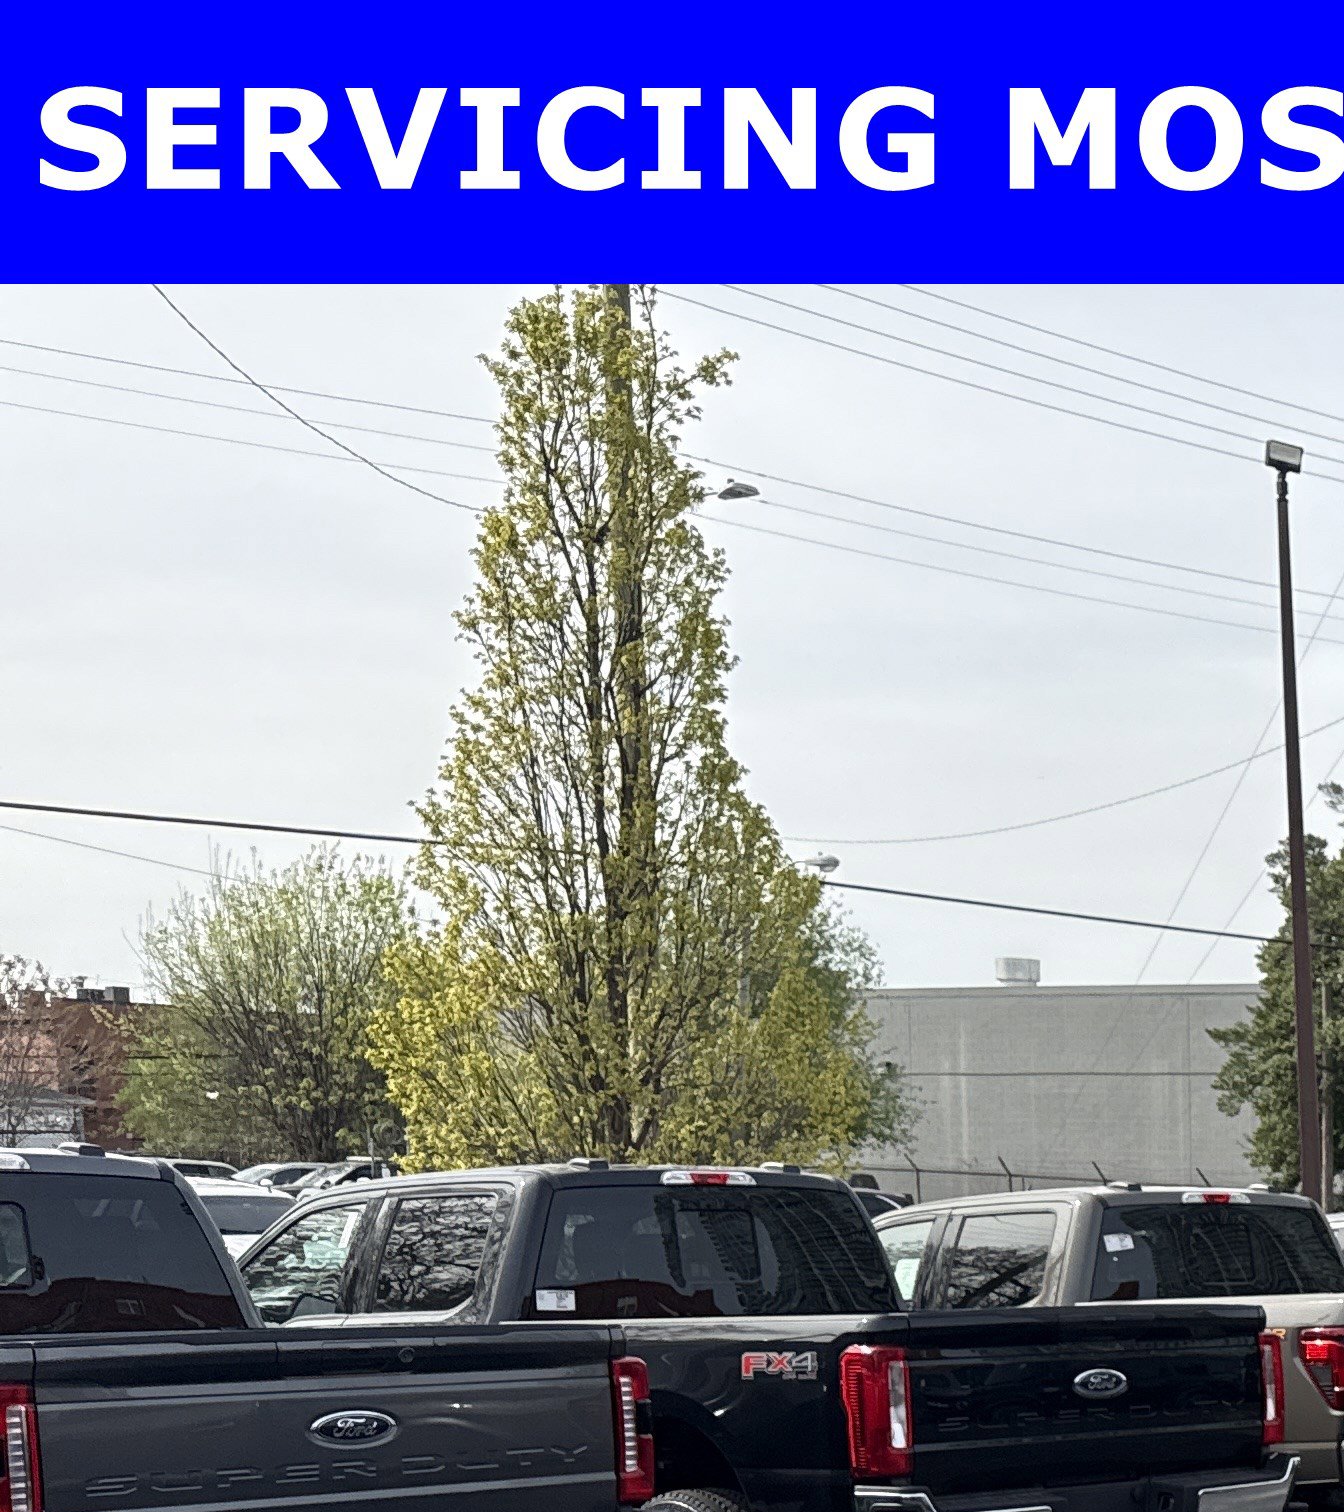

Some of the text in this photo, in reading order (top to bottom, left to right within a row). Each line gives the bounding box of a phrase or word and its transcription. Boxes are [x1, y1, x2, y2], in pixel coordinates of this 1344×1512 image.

[741, 1351, 818, 1380] FX4
[85, 1445, 588, 1497] SUPER DUTY
